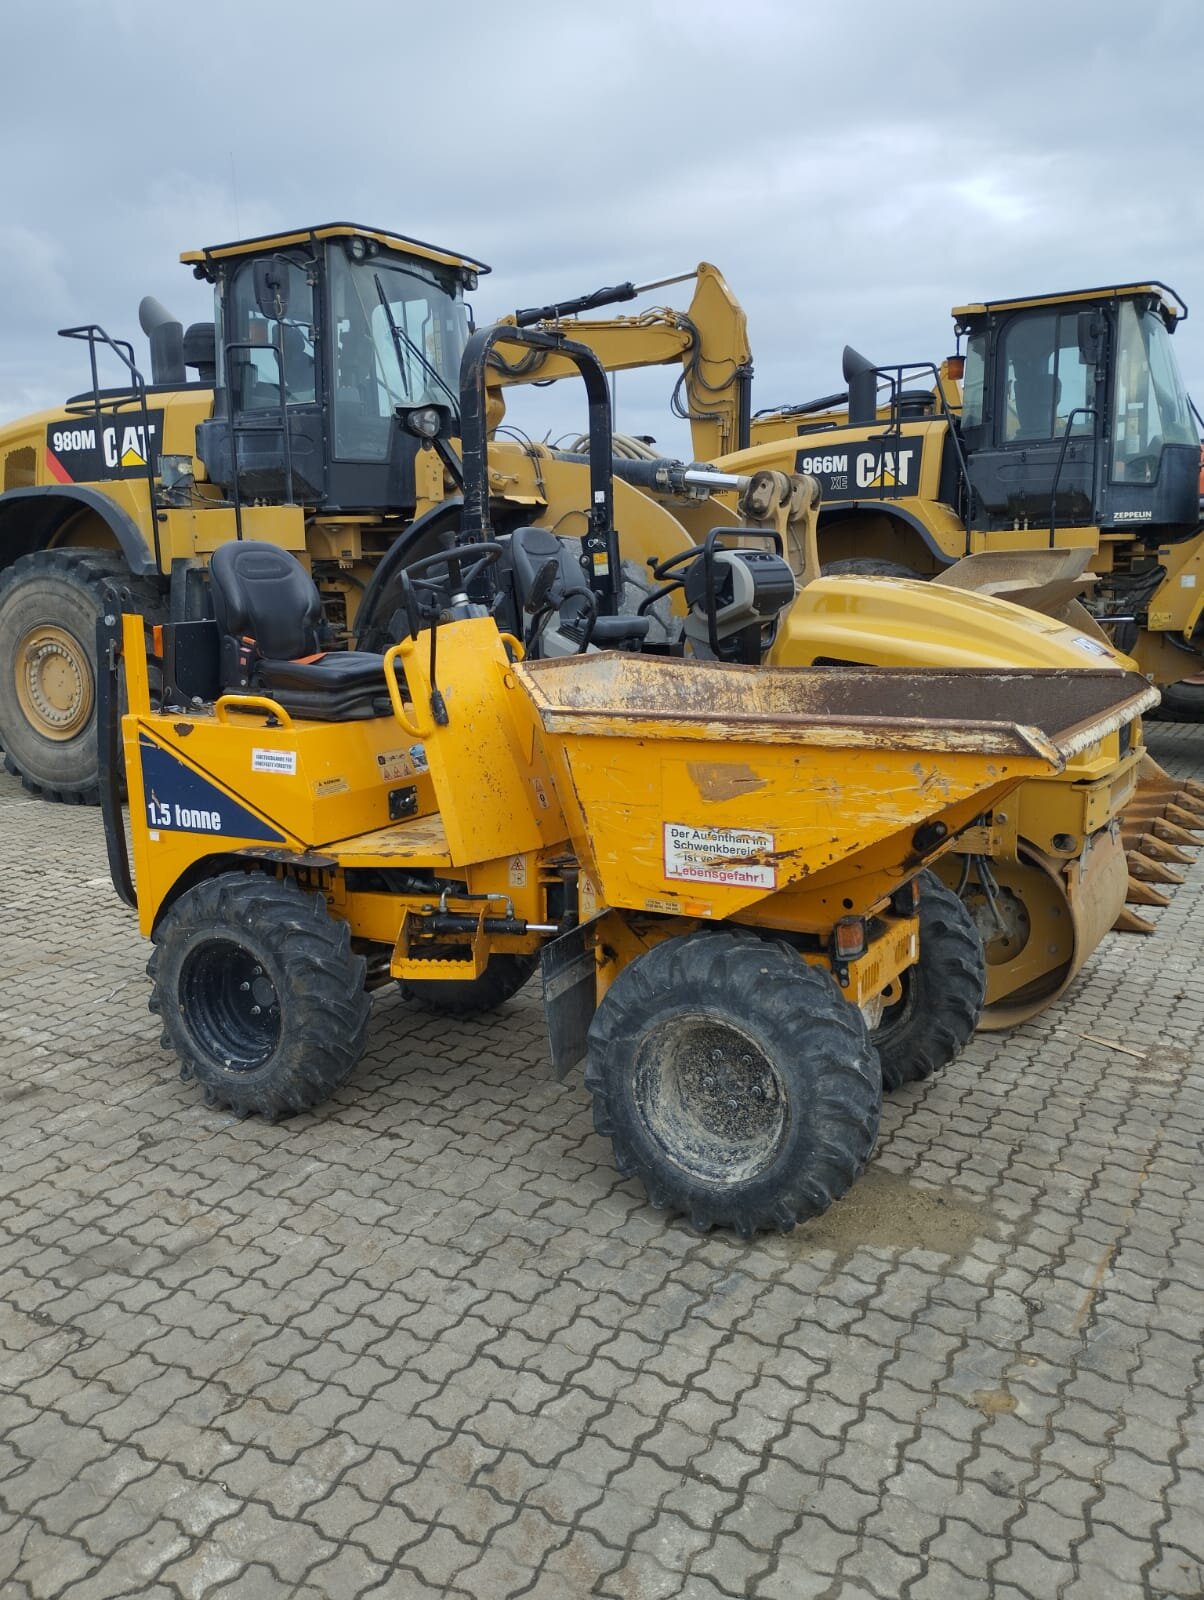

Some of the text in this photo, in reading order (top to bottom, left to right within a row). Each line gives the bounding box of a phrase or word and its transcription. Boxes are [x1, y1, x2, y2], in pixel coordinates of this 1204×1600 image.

[54, 430, 96, 451] 980M
[103, 425, 156, 467] CAT
[803, 455, 848, 475] 966M
[856, 450, 913, 487] CAT
[830, 475, 848, 490] XE
[148, 802, 222, 831] 1.5 tonne
[671, 828, 690, 839] Der
[673, 840, 765, 856] Schwenkbereic
